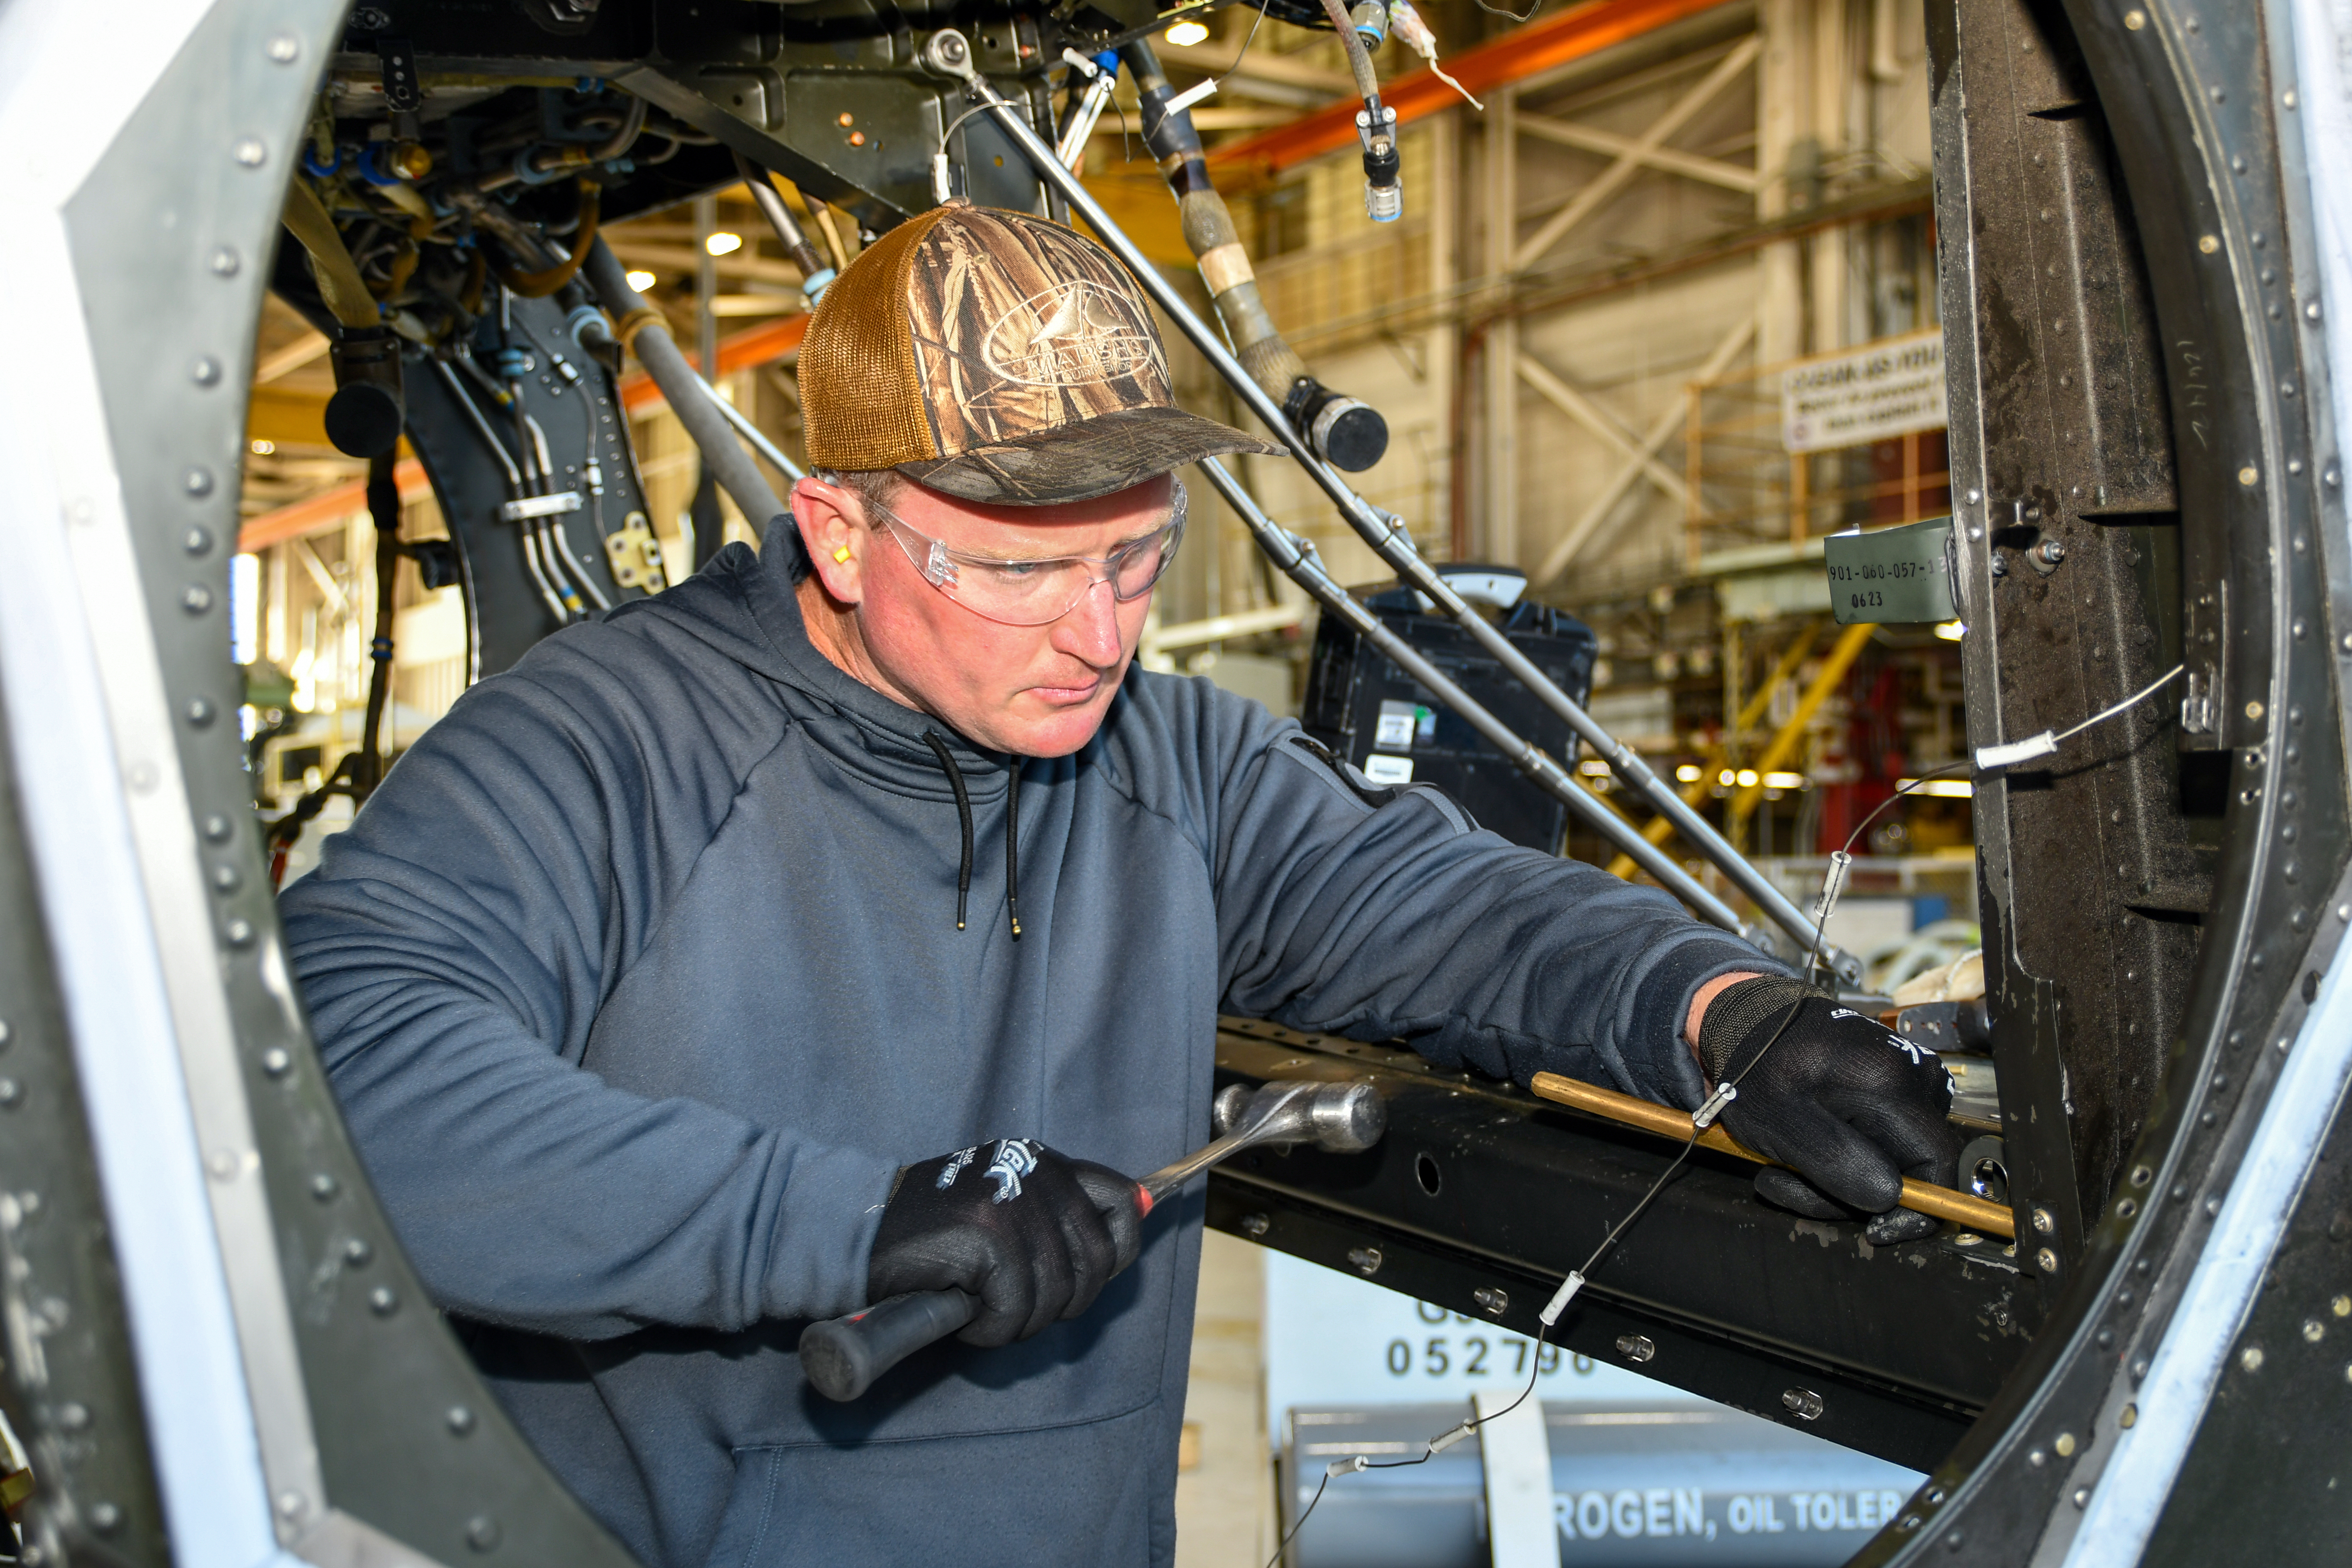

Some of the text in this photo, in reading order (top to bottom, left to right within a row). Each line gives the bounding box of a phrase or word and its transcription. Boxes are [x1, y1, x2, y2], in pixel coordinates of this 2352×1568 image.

[1851, 591, 1883, 608] 0623
[1475, 1487, 1718, 1543] ROGEN,
[1728, 1495, 1786, 1534] OIL
